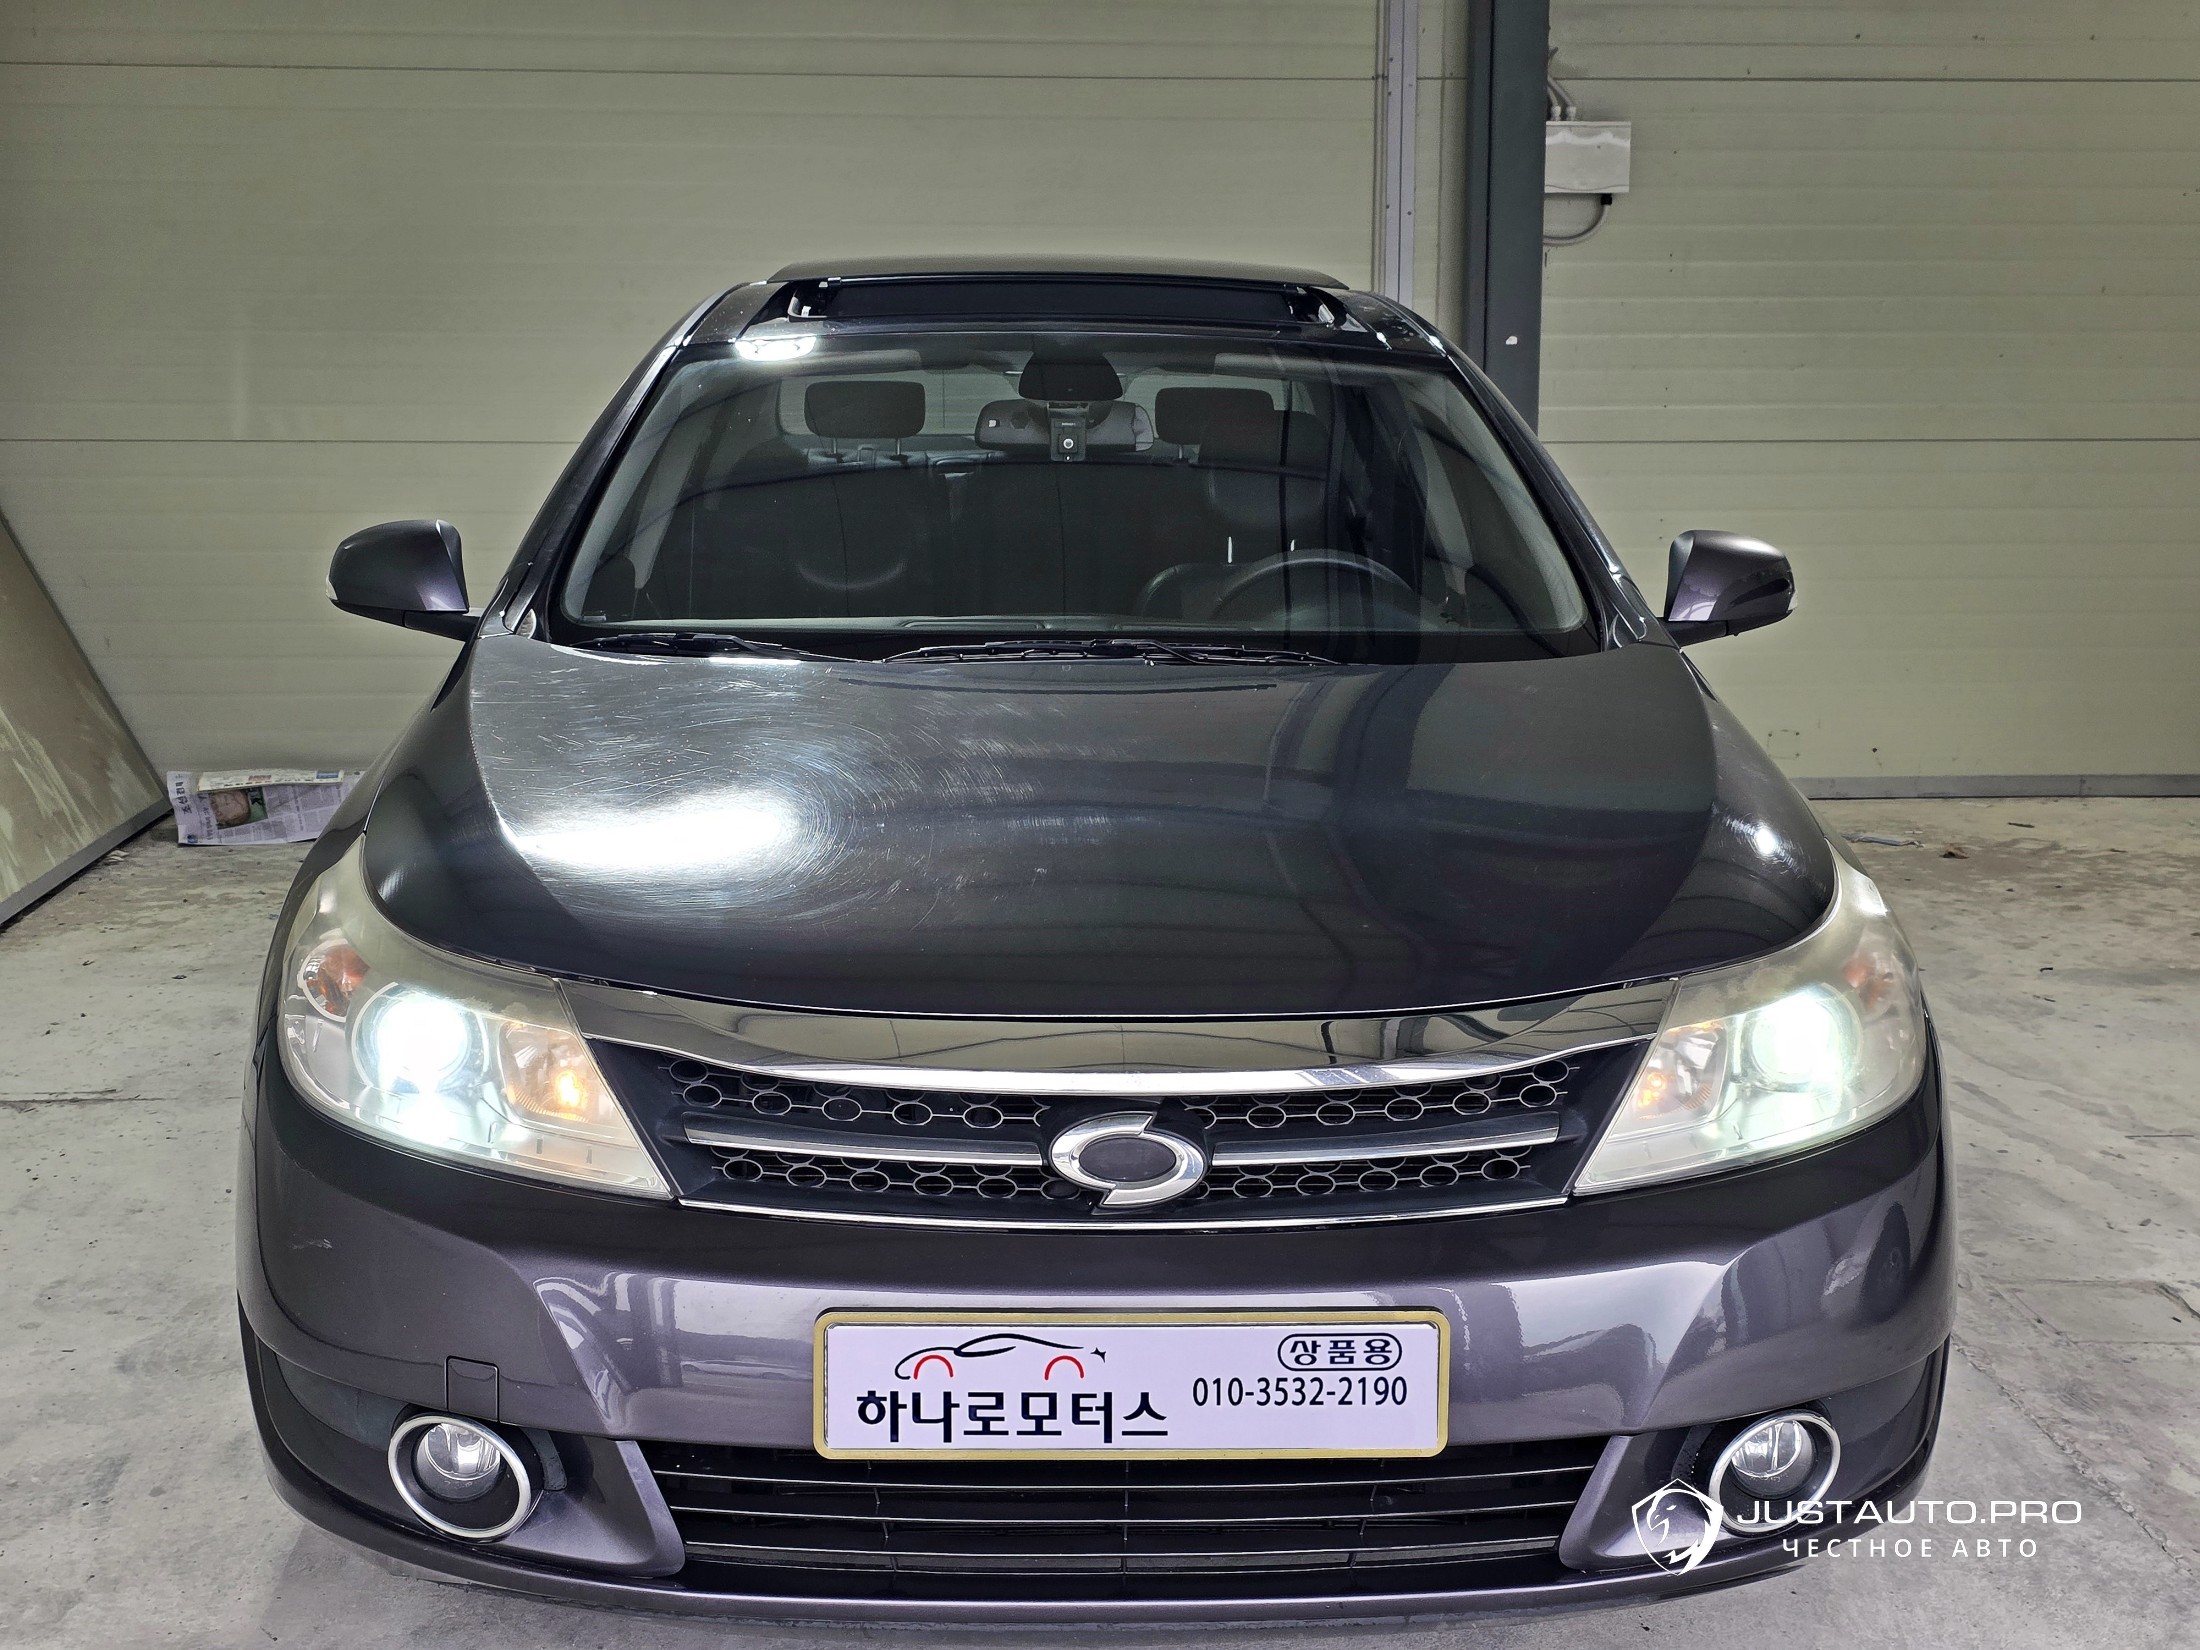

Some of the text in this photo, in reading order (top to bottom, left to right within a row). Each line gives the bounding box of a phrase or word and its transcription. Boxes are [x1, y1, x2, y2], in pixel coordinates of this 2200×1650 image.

[1289, 1338, 1393, 1367] 상품용
[1193, 1376, 1408, 1407] 010-3532-2190
[856, 1390, 1169, 1444] 하나로모터스
